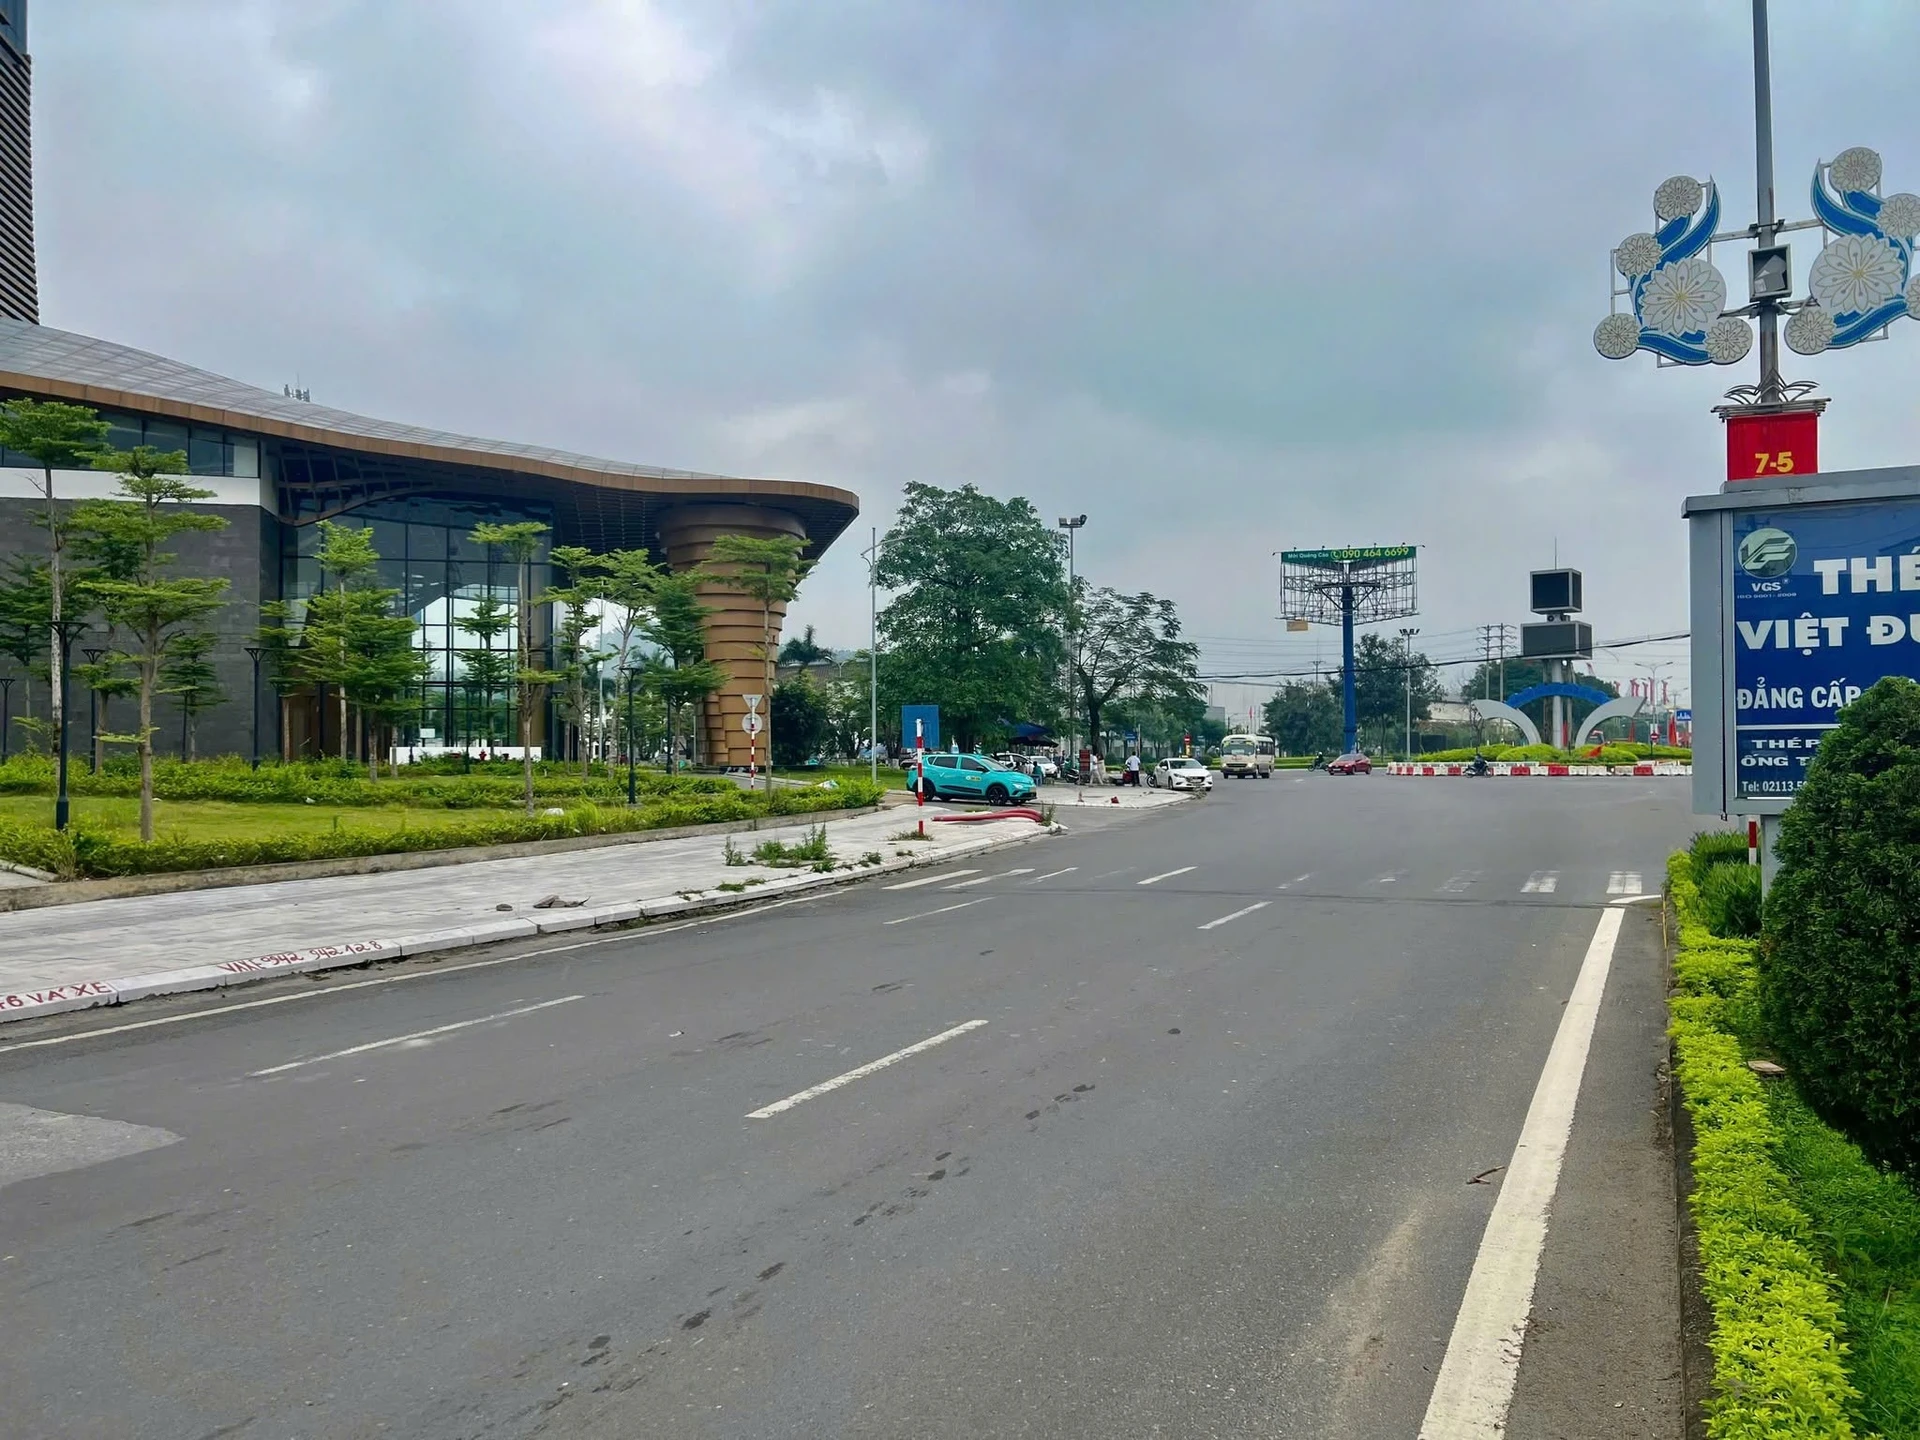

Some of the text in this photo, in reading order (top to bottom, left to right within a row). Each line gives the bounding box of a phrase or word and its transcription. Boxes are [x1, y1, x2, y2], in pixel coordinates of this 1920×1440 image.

[1754, 451, 1794, 474] 7-5
[1342, 549, 1360, 559] 090
[1363, 548, 1381, 558] 464
[1384, 547, 1409, 557] 6699
[1751, 582, 1782, 592] VGS
[1736, 612, 1849, 656] VIỆT
[1737, 676, 1861, 709] ĐẲNG CẤP
[1751, 737, 1820, 749] THÉP
[1740, 753, 1789, 767] ỐNG
[1741, 780, 1760, 793] Tel:
[71, 981, 112, 997] XE
